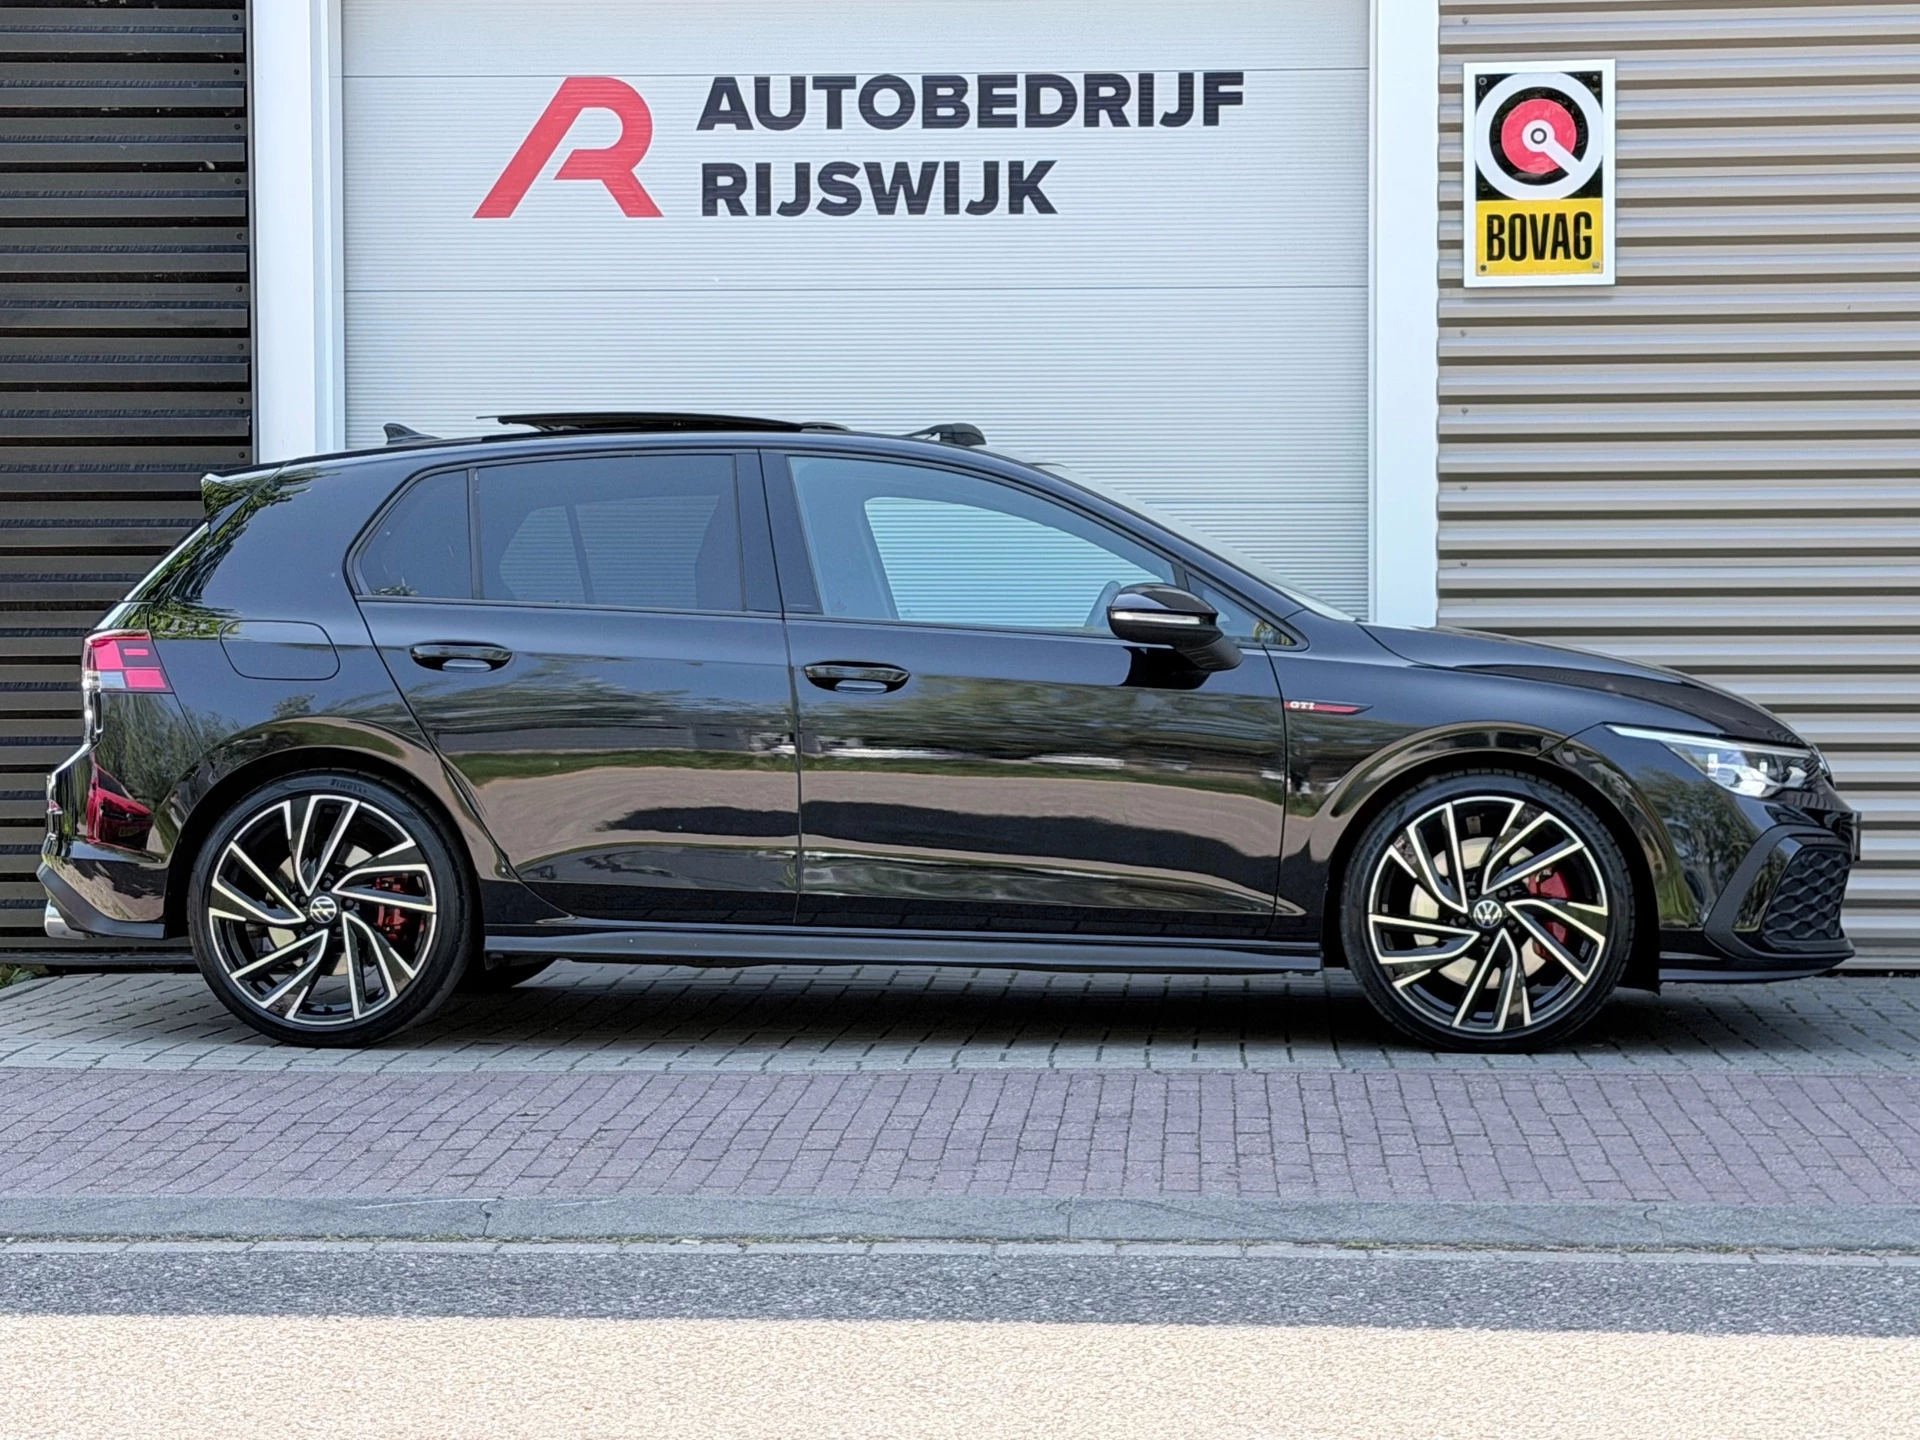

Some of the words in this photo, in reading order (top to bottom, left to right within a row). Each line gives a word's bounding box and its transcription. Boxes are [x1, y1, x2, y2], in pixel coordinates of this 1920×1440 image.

[696, 71, 1244, 131] AUTOBEDRIJF
[701, 160, 1058, 218] RIJSWIJK
[1487, 211, 1592, 261] BOVAG
[1289, 701, 1315, 710] GTI
